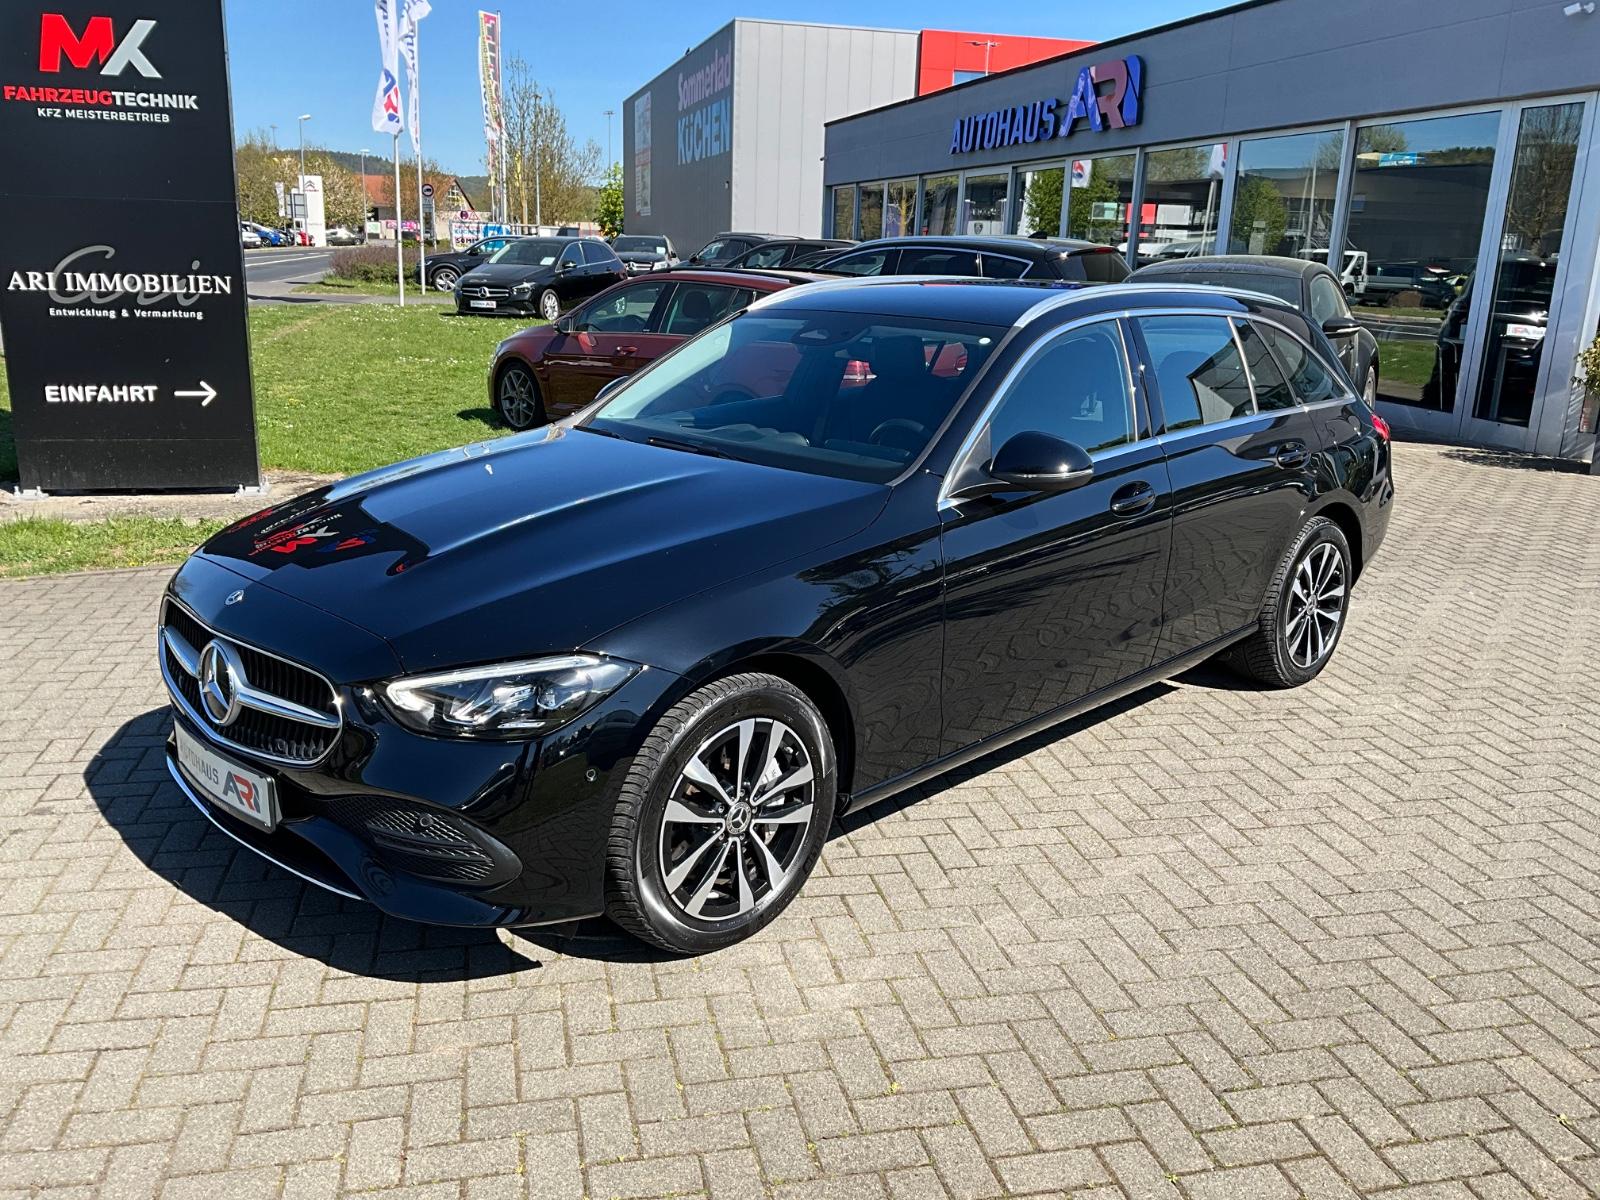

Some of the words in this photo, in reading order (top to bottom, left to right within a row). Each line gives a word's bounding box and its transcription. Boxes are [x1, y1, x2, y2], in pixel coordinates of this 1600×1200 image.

[40, 13, 163, 78] MK
[677, 40, 732, 112] Sommerlad
[3, 85, 199, 110] FAHRZEUGTECHNIK
[950, 98, 1056, 154] AUTOHAUS
[1059, 54, 1143, 137] ARI
[37, 107, 62, 118] KFZ
[65, 109, 170, 123] MEISTERBETRIEB
[677, 95, 731, 165] KÜCHEN
[7, 271, 57, 291] ARI
[63, 272, 232, 294] IMMOBILIEN
[49, 307, 117, 319] Entwicklung
[121, 309, 129, 317] &
[134, 308, 204, 320] Vermarktung
[44, 385, 159, 402] EINFAHRT
[222, 770, 261, 814] ARI
